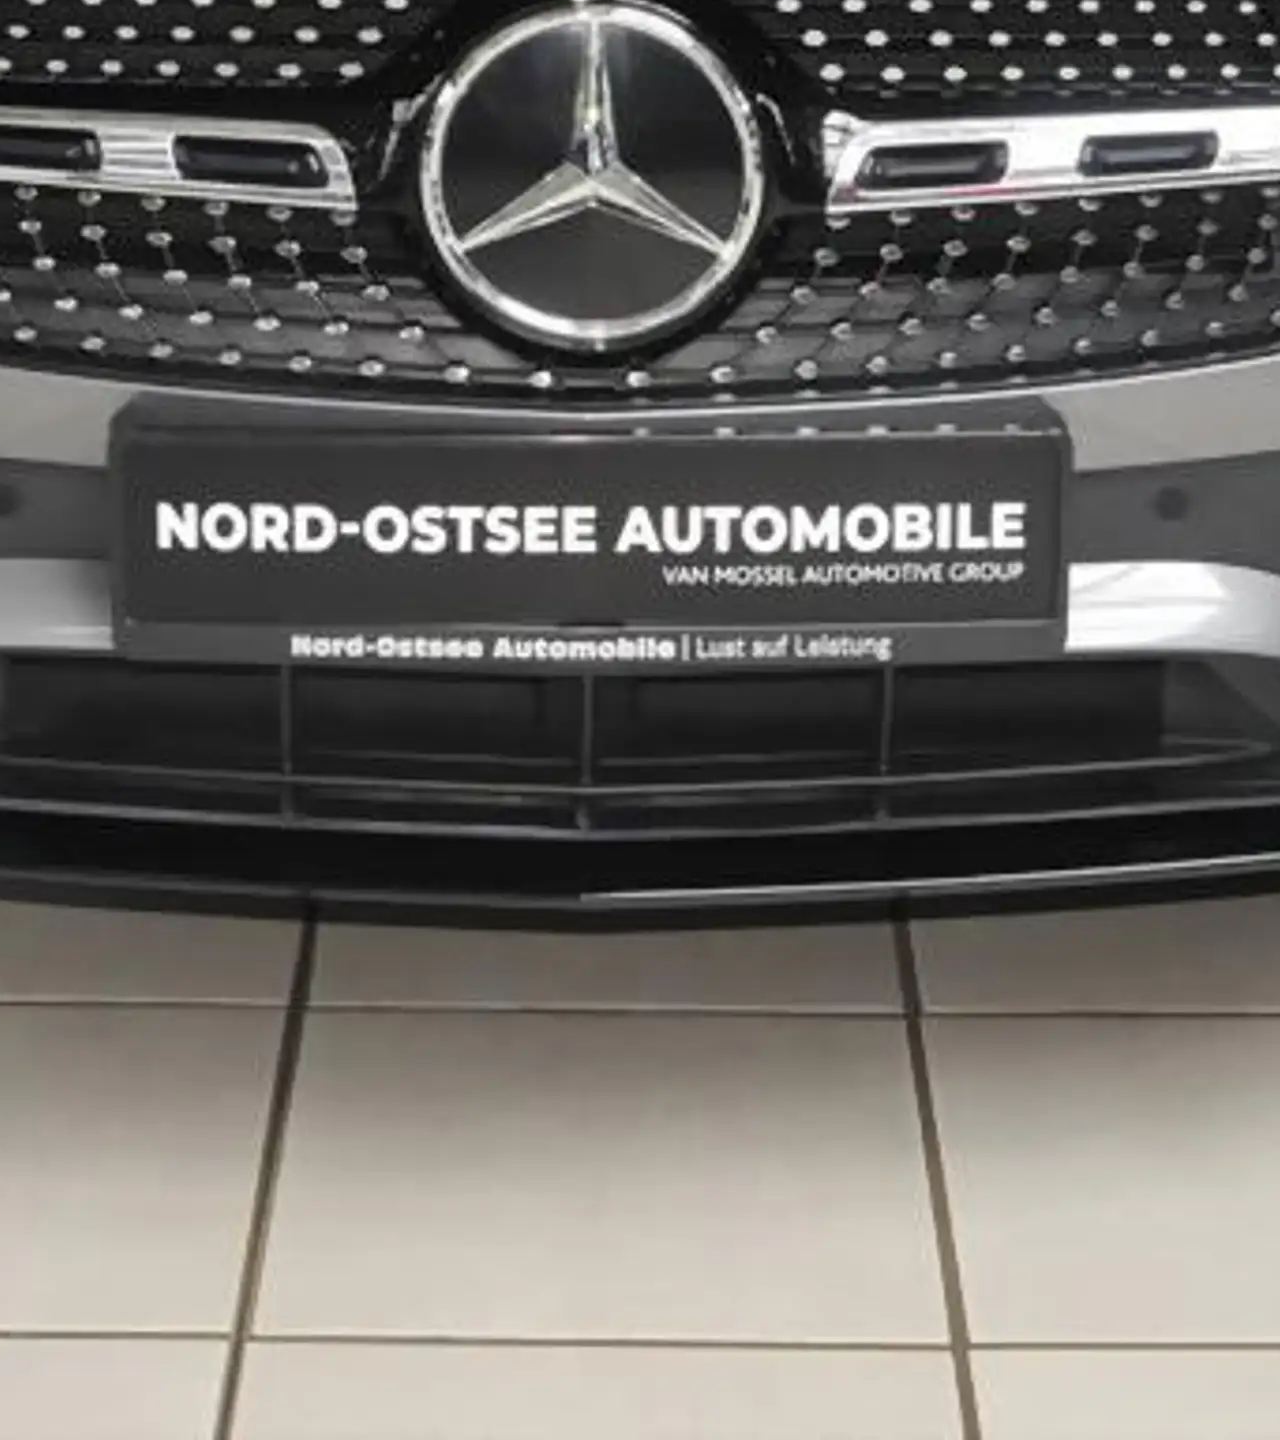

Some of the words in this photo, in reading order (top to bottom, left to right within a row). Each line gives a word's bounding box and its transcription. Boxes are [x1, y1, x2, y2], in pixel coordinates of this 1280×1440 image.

[155, 502, 598, 554] NORD-OSTSEE
[614, 502, 1027, 554] AUTOMOBILE
[662, 565, 709, 586] VAN
[714, 564, 797, 587] MOSSEL
[801, 563, 944, 587] AUTOMOTIVE
[948, 561, 1025, 583] GROUP
[290, 634, 485, 659] Nord-Ostsee
[492, 634, 676, 660] Automobile
[695, 634, 745, 659] Lust
[751, 634, 789, 658] auf
[793, 633, 893, 660] Leistung
